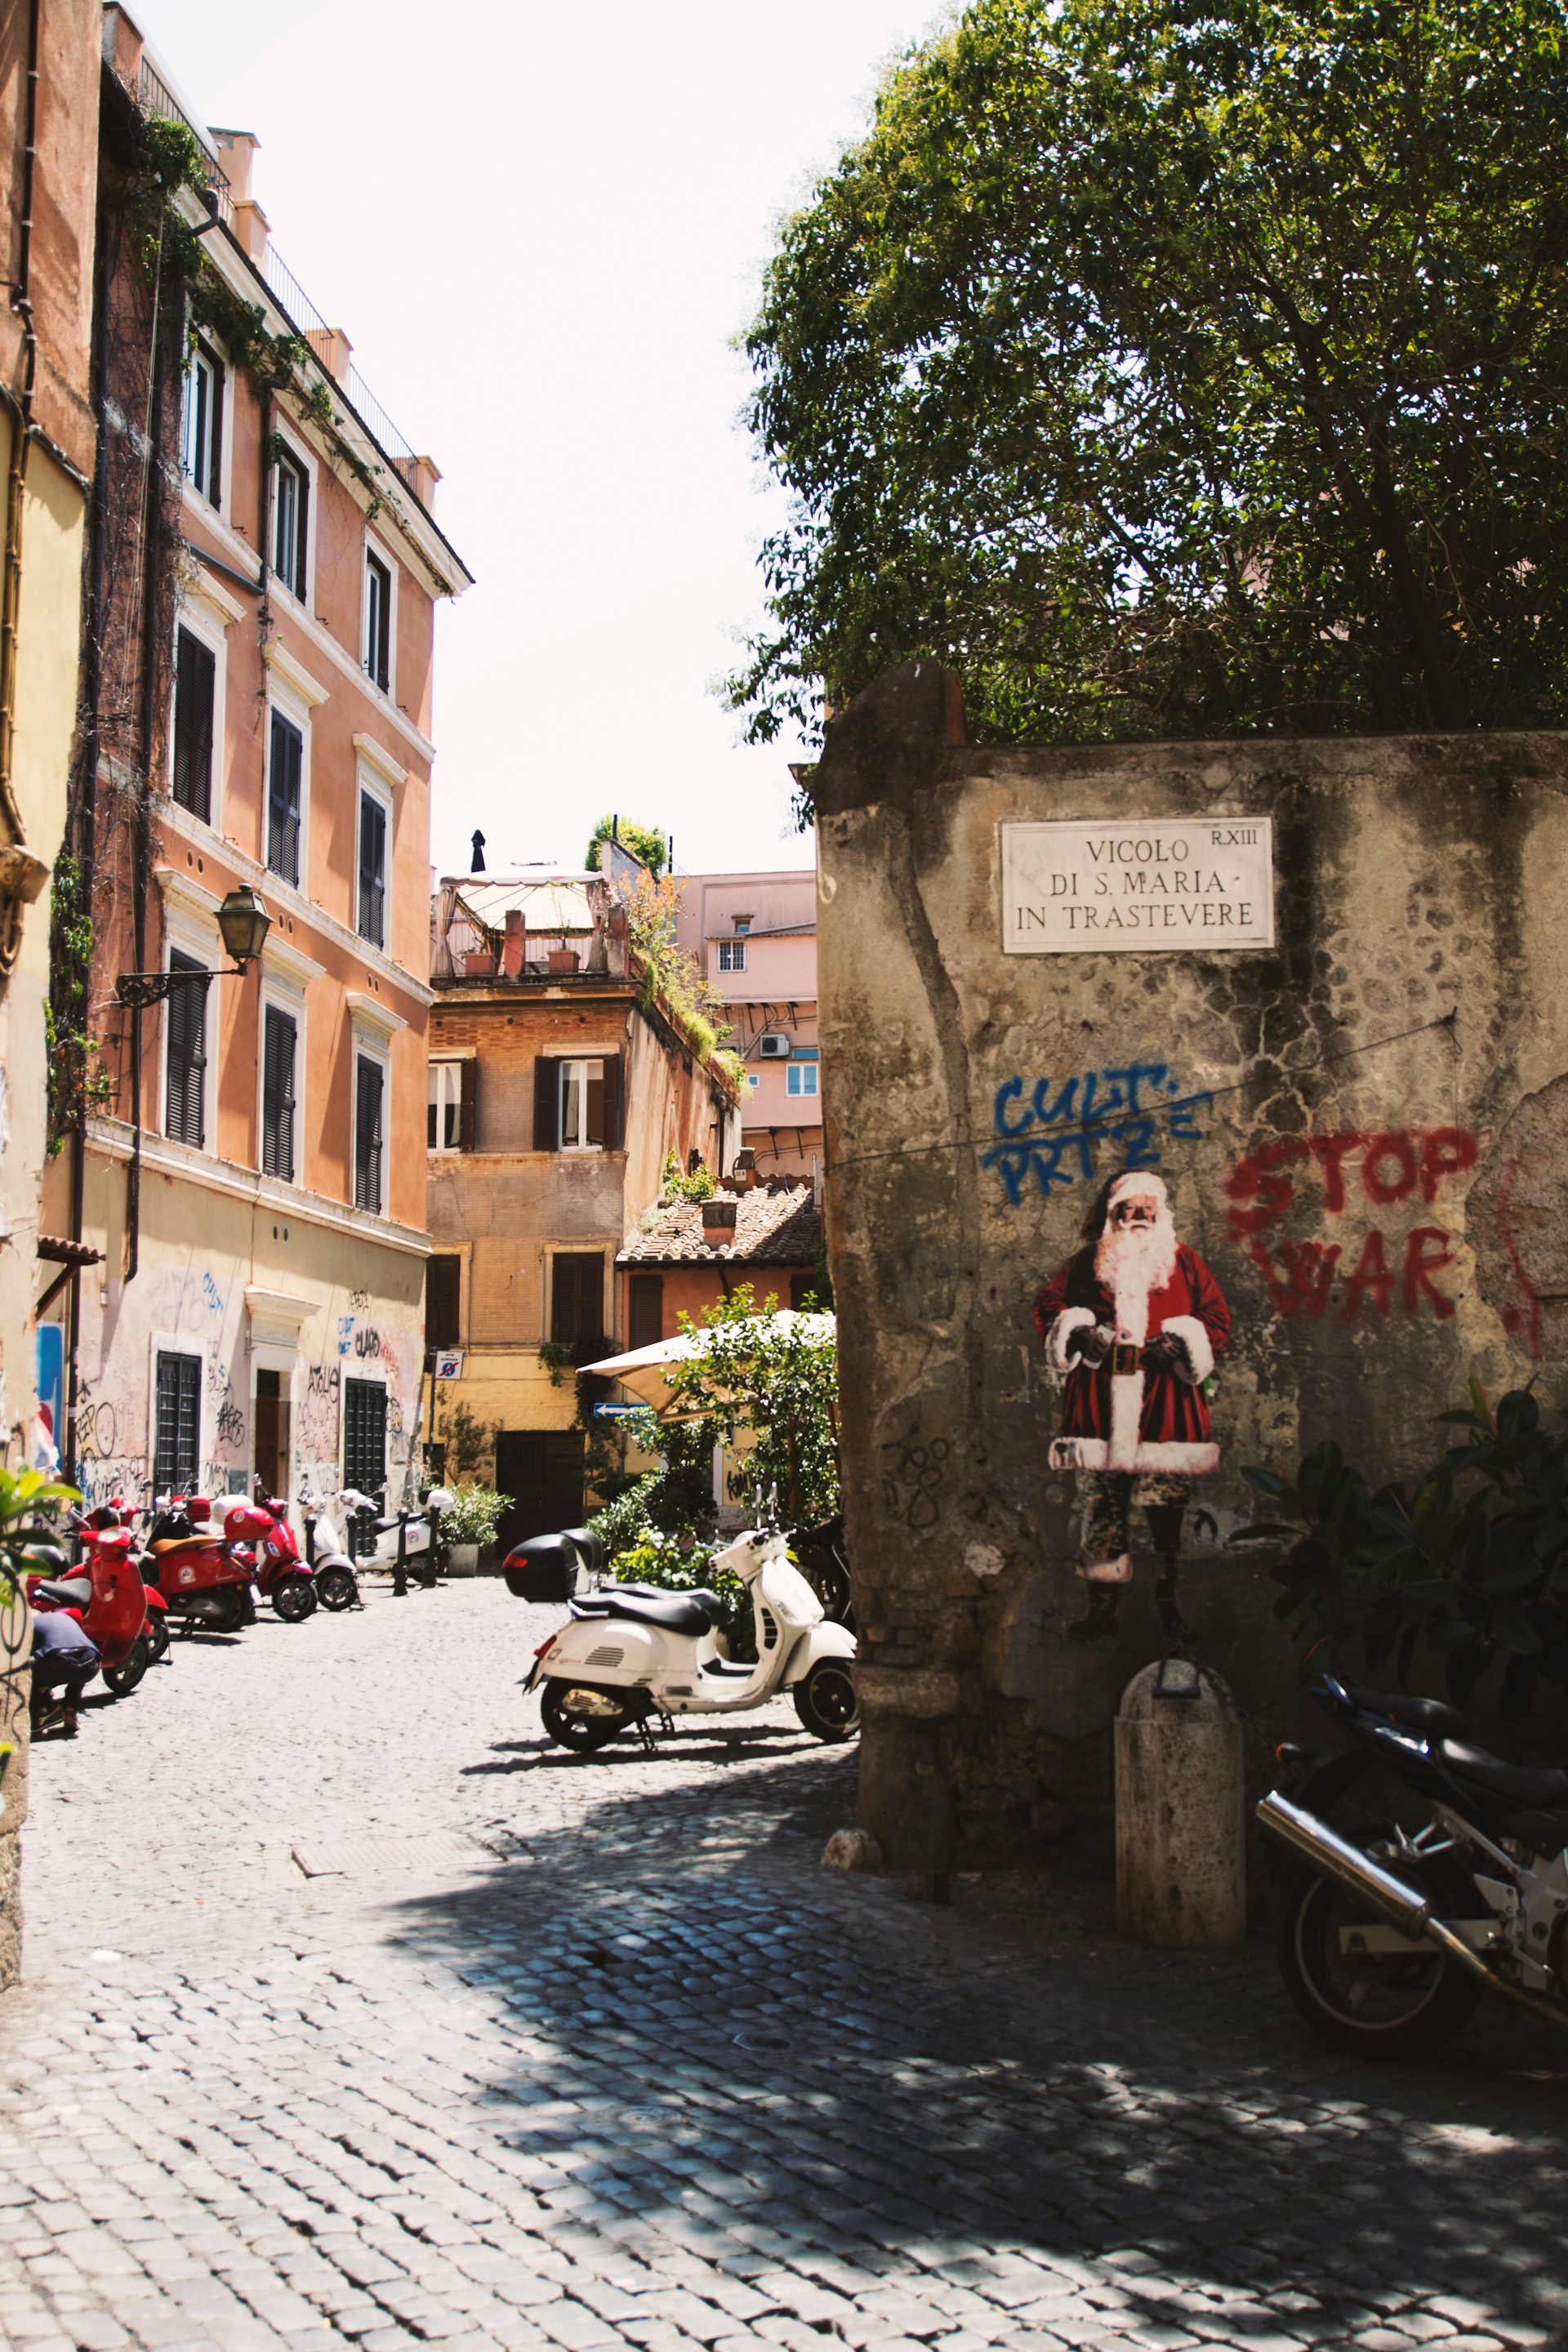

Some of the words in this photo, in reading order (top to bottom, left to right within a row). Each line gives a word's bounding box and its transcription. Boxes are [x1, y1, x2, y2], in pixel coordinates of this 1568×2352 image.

[1085, 839, 1189, 863] VICOLO
[1211, 829, 1258, 846] R.XIII
[1050, 872, 1079, 897] DI
[1094, 871, 1113, 896] S.
[1123, 870, 1226, 895] MARIA
[1017, 906, 1047, 930] IN
[1062, 902, 1254, 929] TRASTEVERE
[1225, 1125, 1478, 1243] STOP
[1249, 1227, 1455, 1323] WAR
